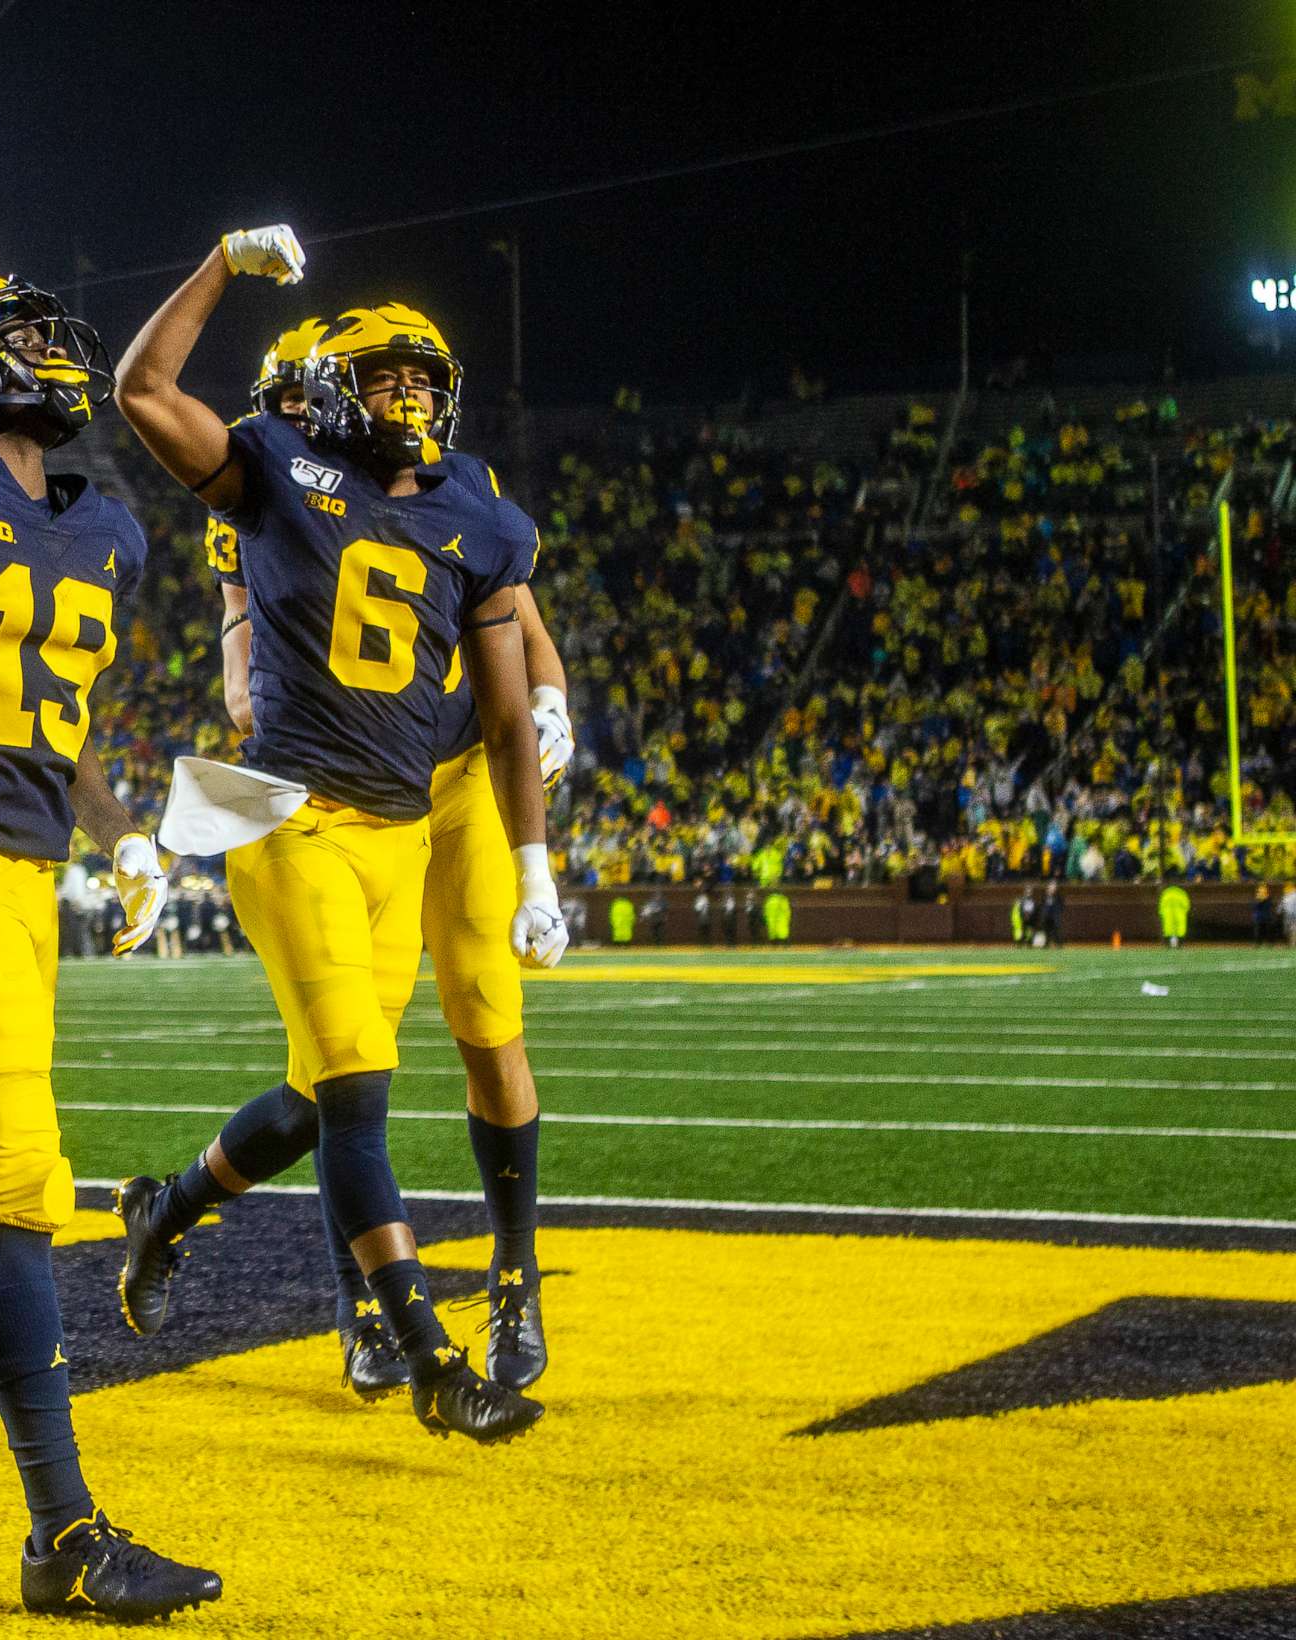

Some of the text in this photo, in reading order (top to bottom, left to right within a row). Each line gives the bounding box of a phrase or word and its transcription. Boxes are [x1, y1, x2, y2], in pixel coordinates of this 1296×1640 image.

[1251, 272, 1296, 312] 4:
[291, 458, 343, 493] 150
[328, 538, 428, 695] 6
[499, 1267, 524, 1287] M
[355, 1297, 383, 1318] M
